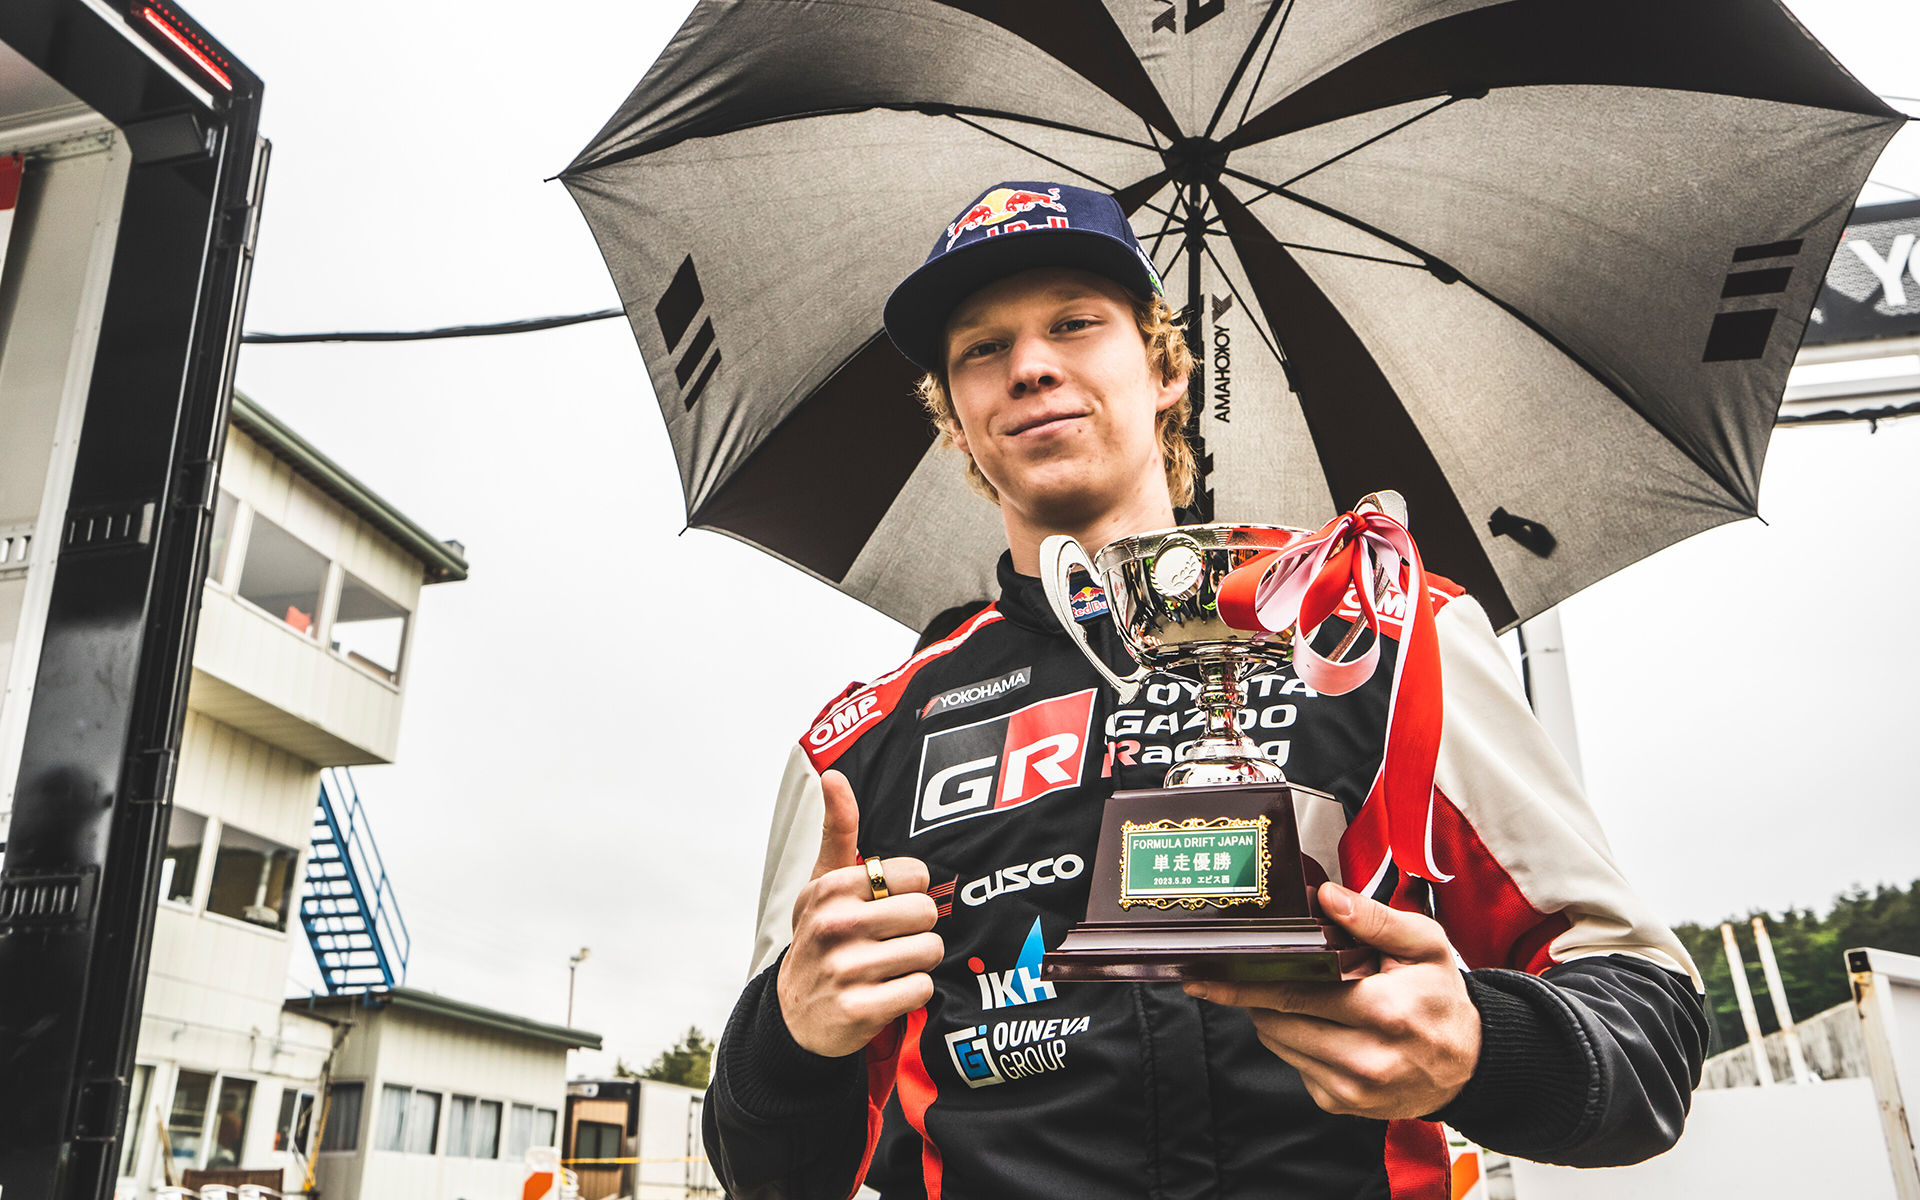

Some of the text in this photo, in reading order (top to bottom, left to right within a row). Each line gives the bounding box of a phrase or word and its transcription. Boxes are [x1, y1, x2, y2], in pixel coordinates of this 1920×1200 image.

[1848, 233, 1920, 306] Y
[1092, 600, 1108, 612] Bu
[1343, 588, 1435, 619] OM
[939, 671, 1026, 708] YOKOHAMA
[809, 695, 878, 746] OMP
[921, 732, 1080, 821] GR
[1133, 835, 1253, 850] FORMULA DRIFT JAPAN
[1152, 851, 1232, 872] 単走優勝
[960, 853, 1085, 907] CUSCO
[1153, 876, 1192, 885] 2023.5.20
[993, 1015, 1091, 1051] OUNEVA
[1000, 1039, 1067, 1079] GROUP
